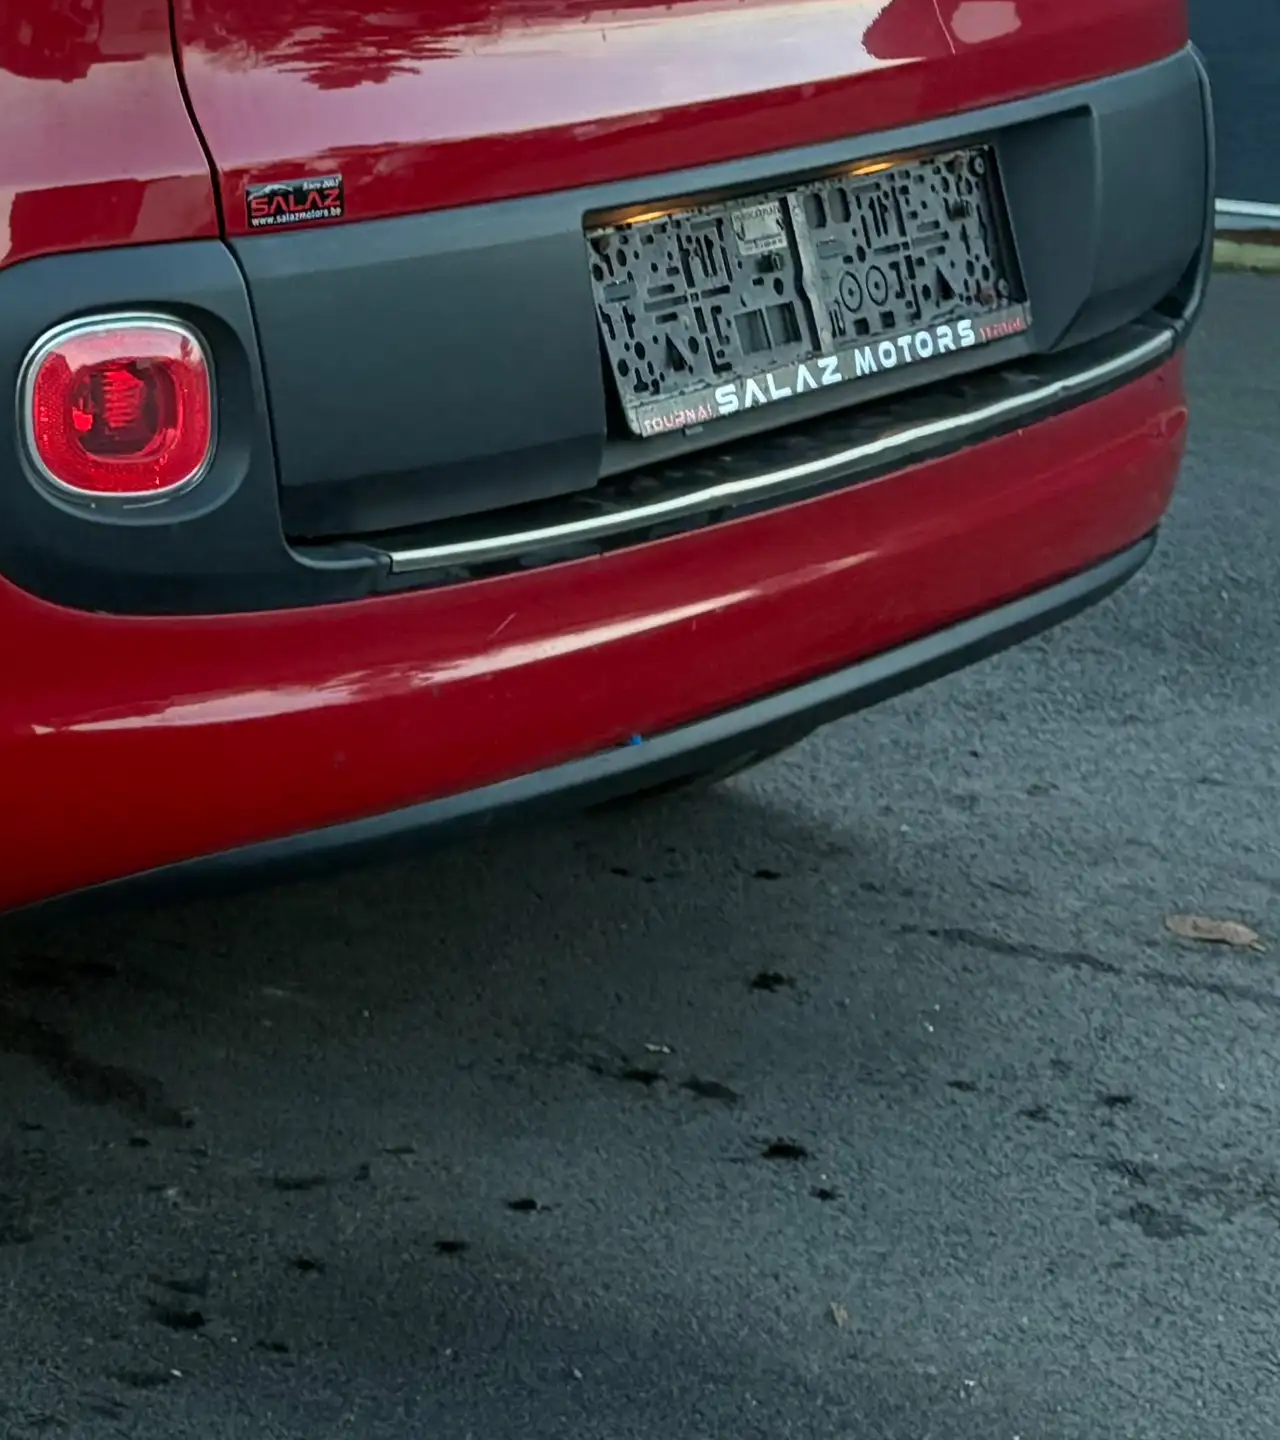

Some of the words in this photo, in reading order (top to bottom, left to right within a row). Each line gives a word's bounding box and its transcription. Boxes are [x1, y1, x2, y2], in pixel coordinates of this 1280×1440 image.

[251, 188, 341, 217] SALAZ
[714, 355, 844, 415] SALAZ
[853, 318, 976, 378] MOTORS
